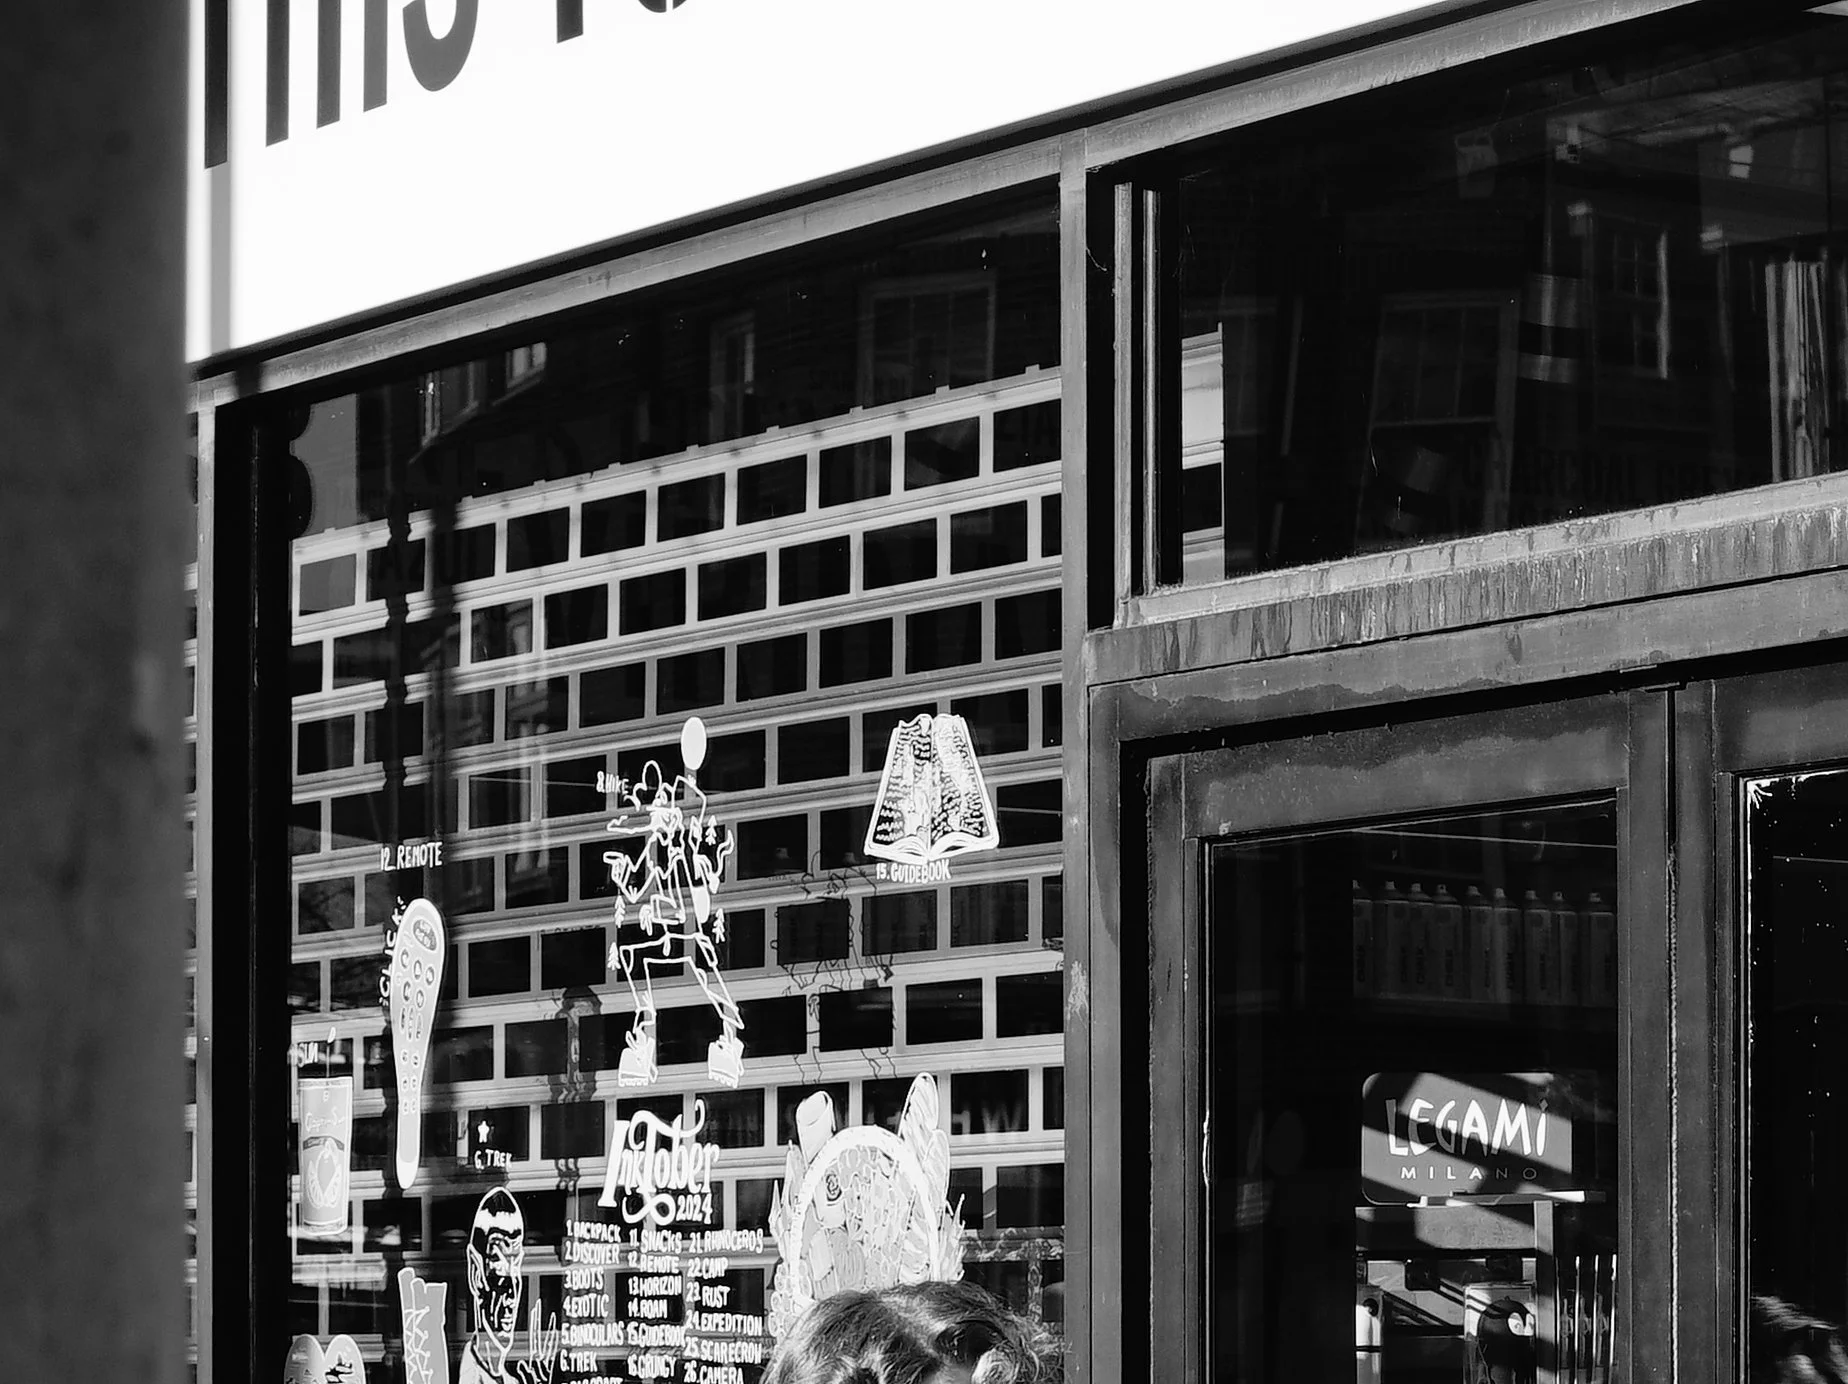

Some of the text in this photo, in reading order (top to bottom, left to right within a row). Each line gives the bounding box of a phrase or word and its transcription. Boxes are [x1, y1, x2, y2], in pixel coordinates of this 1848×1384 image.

[397, 841, 443, 870] REMOTE
[890, 859, 952, 884] GUIDEBOOK
[485, 1148, 512, 1173] TREK
[1399, 1165, 1538, 1181] MILANO
[675, 1193, 714, 1225] 2024
[572, 1265, 604, 1291] BOOTS
[639, 1275, 683, 1298] HORIZON
[640, 1298, 668, 1319] ROAM
[702, 1284, 731, 1309] RUST
[701, 1312, 763, 1337] EXPEDITION
[569, 1350, 598, 1373] TREK
[700, 1339, 762, 1365] SCARECROW
